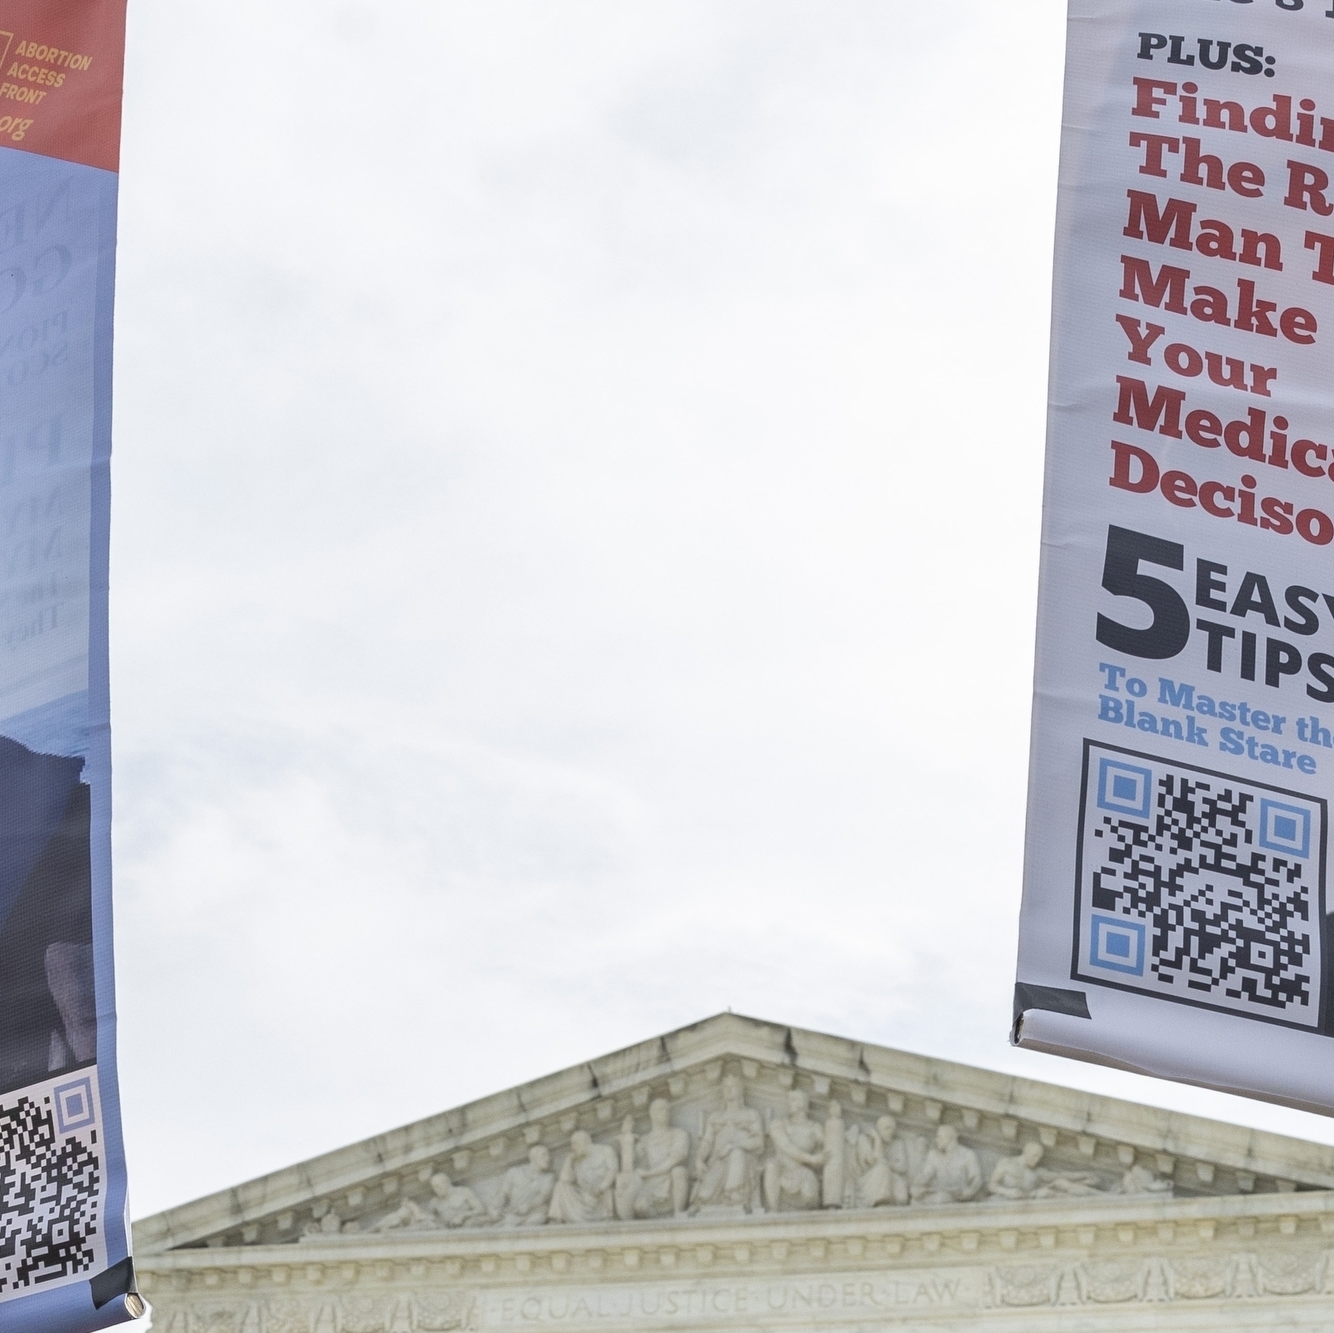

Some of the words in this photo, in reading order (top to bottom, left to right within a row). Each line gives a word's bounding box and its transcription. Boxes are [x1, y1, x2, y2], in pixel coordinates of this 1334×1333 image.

[7, 61, 66, 88] ACCESS
[15, 40, 92, 71] ABORTION
[1137, 32, 1276, 77] PLUS:
[1129, 131, 1265, 198] The
[1123, 188, 1283, 272] Man
[1118, 253, 1318, 346] Make
[1114, 312, 1278, 398] Your
[1095, 523, 1190, 660] 5
[1098, 662, 1148, 698] To
[1157, 676, 1286, 735] Master
[1098, 694, 1208, 748] Blank
[1219, 728, 1317, 775] Stare
[501, 1295, 611, 1322] EQUAL
[620, 1287, 749, 1317] JUSTICE
[768, 1281, 883, 1310] UNDER
[894, 1278, 960, 1305] LAW
